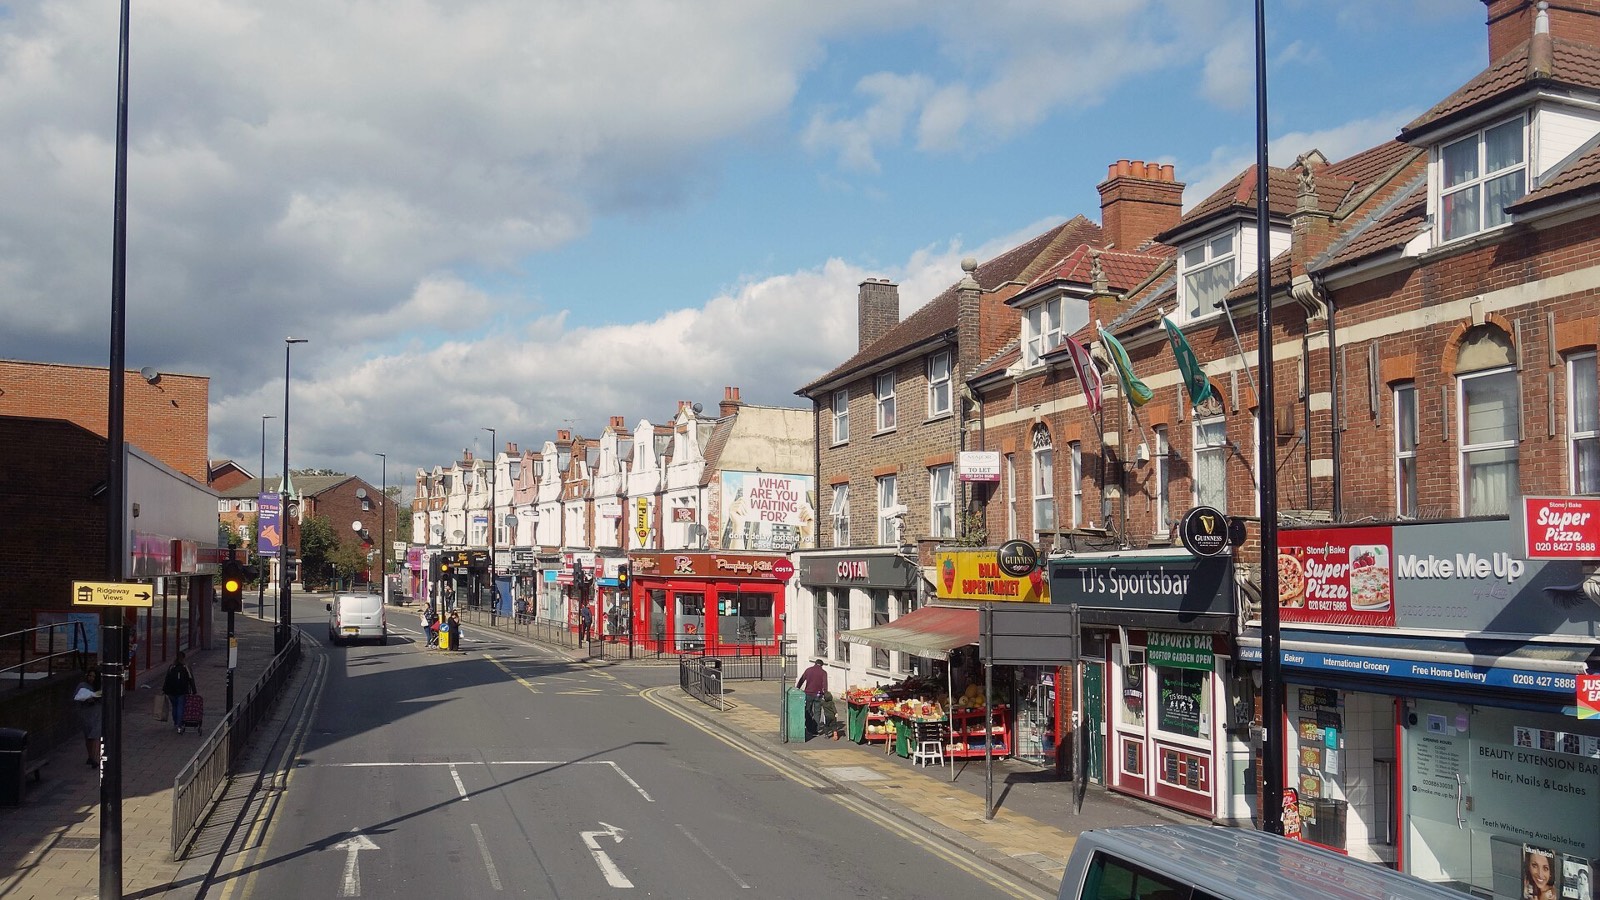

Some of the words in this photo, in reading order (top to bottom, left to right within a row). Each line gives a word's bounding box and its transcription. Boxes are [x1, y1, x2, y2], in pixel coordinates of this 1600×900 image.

[759, 478, 791, 490] WHAT
[750, 488, 772, 499] ARE
[776, 490, 798, 501] YOU
[750, 499, 797, 512] WAITING
[760, 511, 787, 522] FOR?
[1537, 507, 1590, 531] Super
[802, 535, 814, 543] you
[1545, 527, 1582, 541] Pizza
[772, 541, 796, 551] today!
[1306, 546, 1324, 554] Stone
[1330, 546, 1345, 554] Bake
[1536, 543, 1551, 551] 020
[1553, 543, 1573, 551] 8427
[1576, 543, 1596, 551] 5888
[1005, 556, 1034, 565] GUINNESS
[837, 561, 866, 579] COSTA
[978, 563, 1000, 578] BILAL
[1304, 558, 1349, 584] Super
[1398, 554, 1454, 578] Make
[1456, 553, 1492, 578] Me
[1493, 552, 1525, 584] Up
[962, 580, 1020, 596] SUPERMARKET
[1079, 567, 1106, 593] TJ's
[1109, 566, 1189, 600] Sportsbar
[1306, 578, 1348, 599] Pizza
[1308, 600, 1318, 610] 020
[1319, 601, 1332, 610] 8427
[1333, 601, 1347, 611] 5888
[1147, 632, 1159, 645] TJS
[1161, 634, 1191, 648] SPORTS
[1194, 635, 1213, 651] BAR
[1149, 650, 1171, 660] ROOFTOP
[1172, 652, 1194, 663] GARDEN
[1196, 654, 1212, 664] OPEN
[1284, 654, 1304, 665] Bakery
[1323, 657, 1362, 669] International
[1363, 661, 1390, 673] Grocery
[1412, 665, 1428, 676] Free
[1430, 667, 1452, 677] Home
[1454, 668, 1486, 682] Delivery
[1513, 674, 1534, 685] 0208
[1536, 676, 1552, 686] 427
[1554, 677, 1575, 688] 5888
[1582, 680, 1600, 692] JUS
[1588, 691, 1600, 701] EA
[1480, 746, 1514, 760] BEAUTY
[1518, 753, 1575, 771] EXTENSION
[1579, 763, 1598, 775] BAR
[1492, 769, 1513, 783] Hair,
[1516, 774, 1540, 787] Nails
[1543, 779, 1551, 789] &
[1553, 780, 1586, 796] Lashes
[1482, 818, 1499, 828] Teeth
[1500, 822, 1533, 838] Whitening
[1535, 831, 1567, 844] Available
[1568, 838, 1586, 848] here
